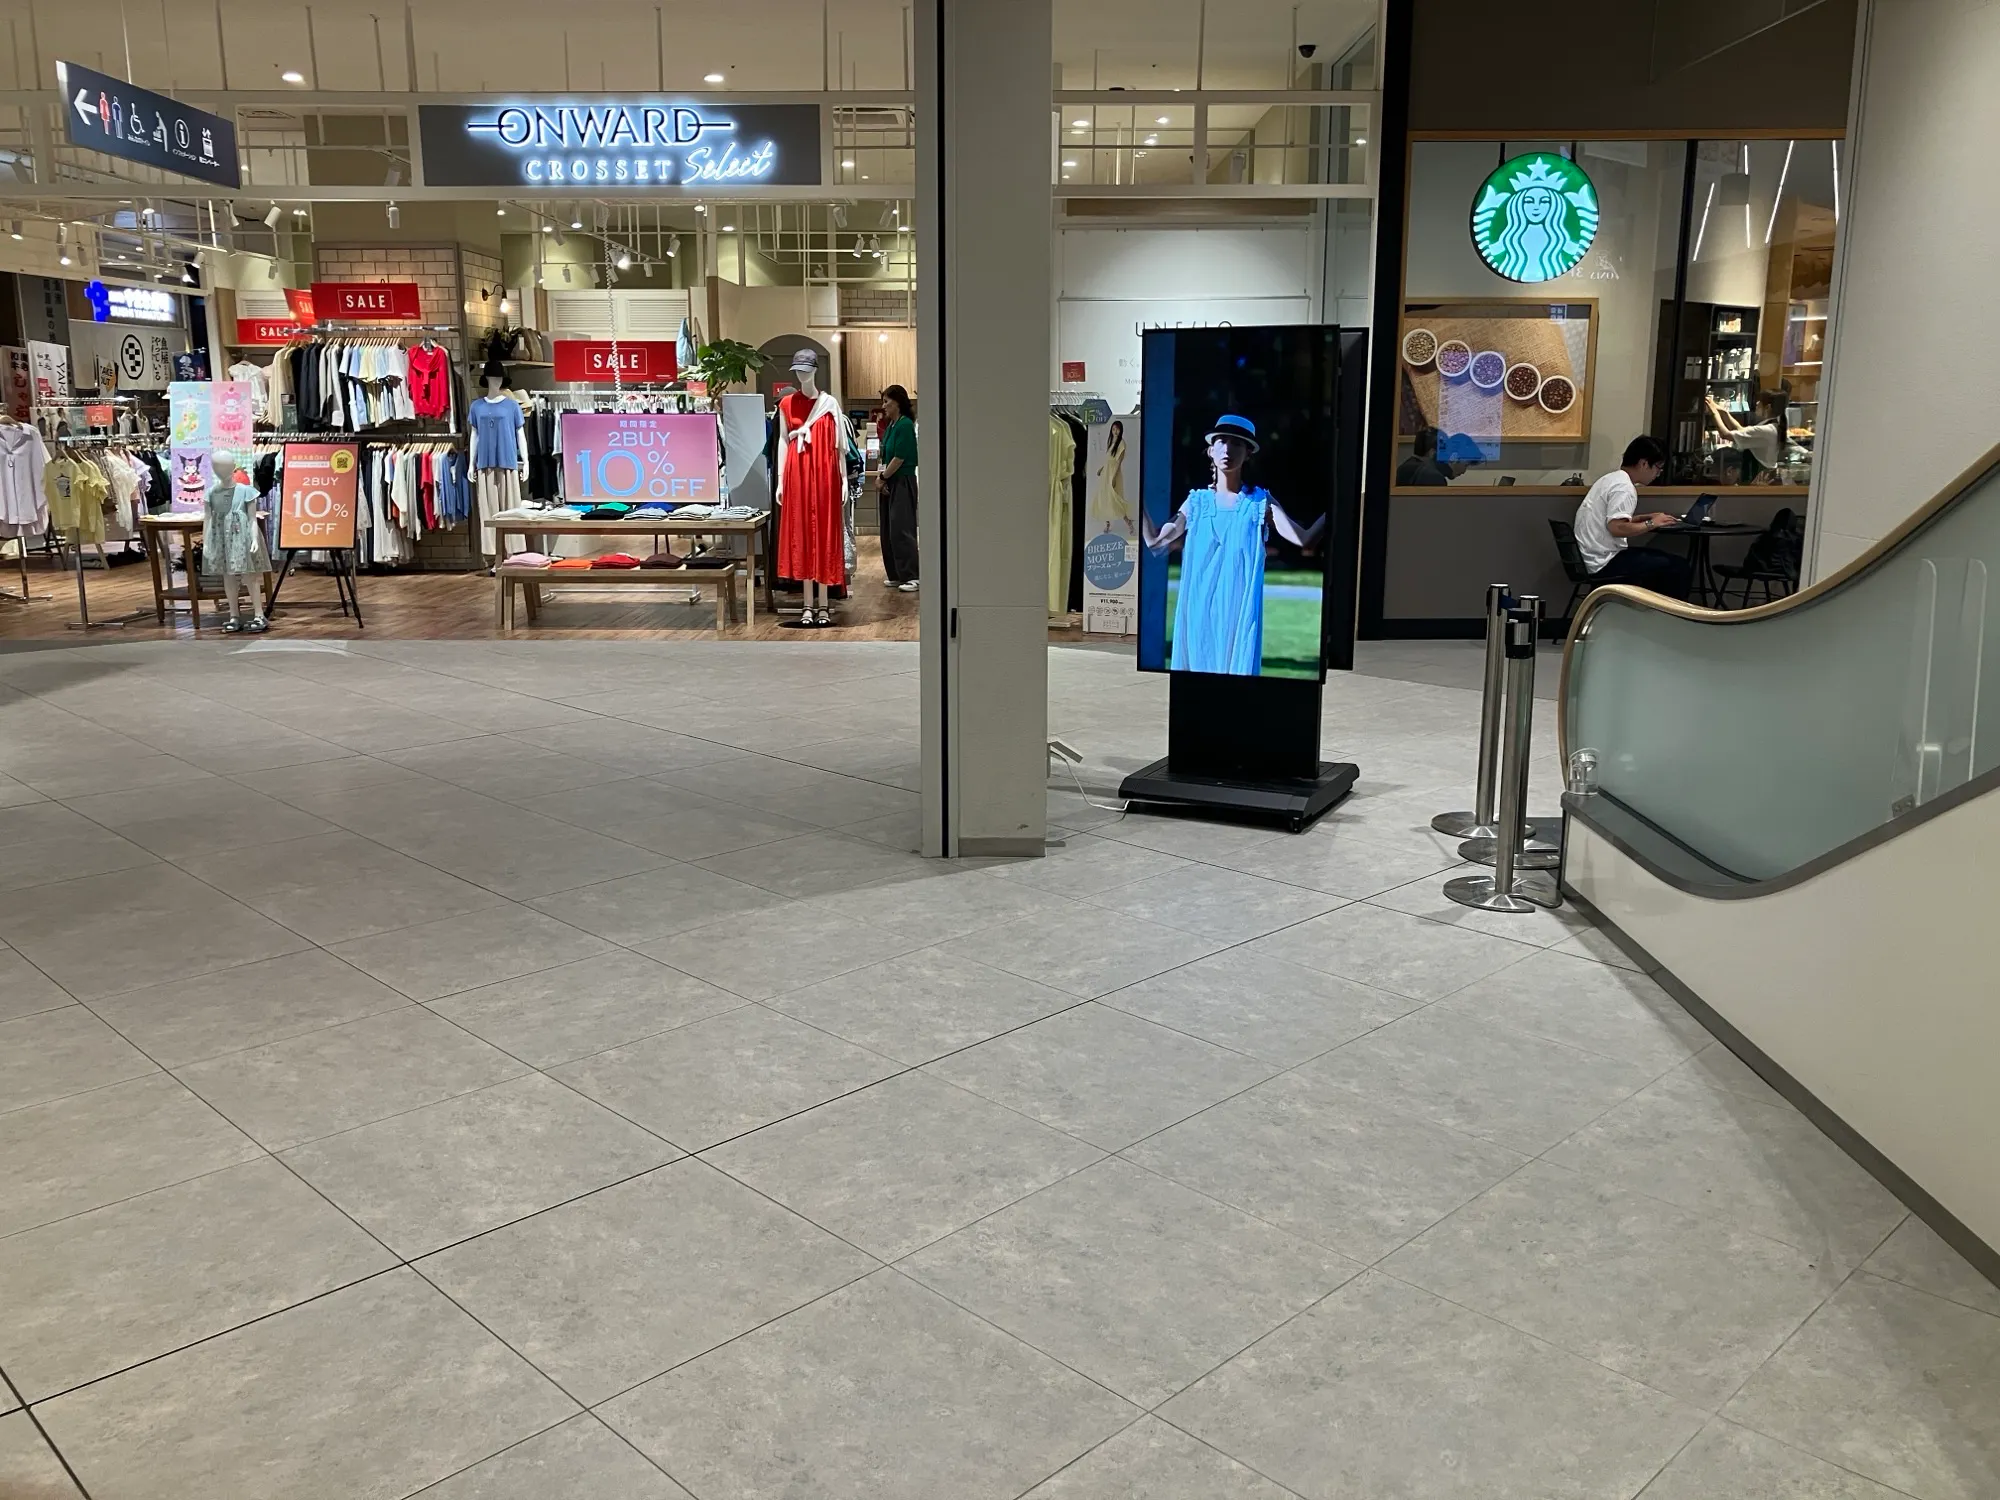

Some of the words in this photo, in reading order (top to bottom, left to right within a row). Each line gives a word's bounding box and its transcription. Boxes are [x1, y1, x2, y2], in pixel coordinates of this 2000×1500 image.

[497, 106, 702, 148] ONWARD
[525, 159, 671, 181] CROSSET
[681, 140, 775, 185] Select
[299, 301, 315, 314] SAL
[346, 295, 386, 309] SALE
[260, 326, 289, 337] SALE
[593, 354, 639, 369] SALE
[608, 431, 671, 447] 2BUY
[303, 477, 340, 486] 2BUY
[649, 477, 706, 497] OFF
[292, 490, 349, 519] 10%
[300, 522, 337, 536] OFF
[1087, 542, 1124, 555] BREEZE
[1087, 553, 1115, 565] MOVE
